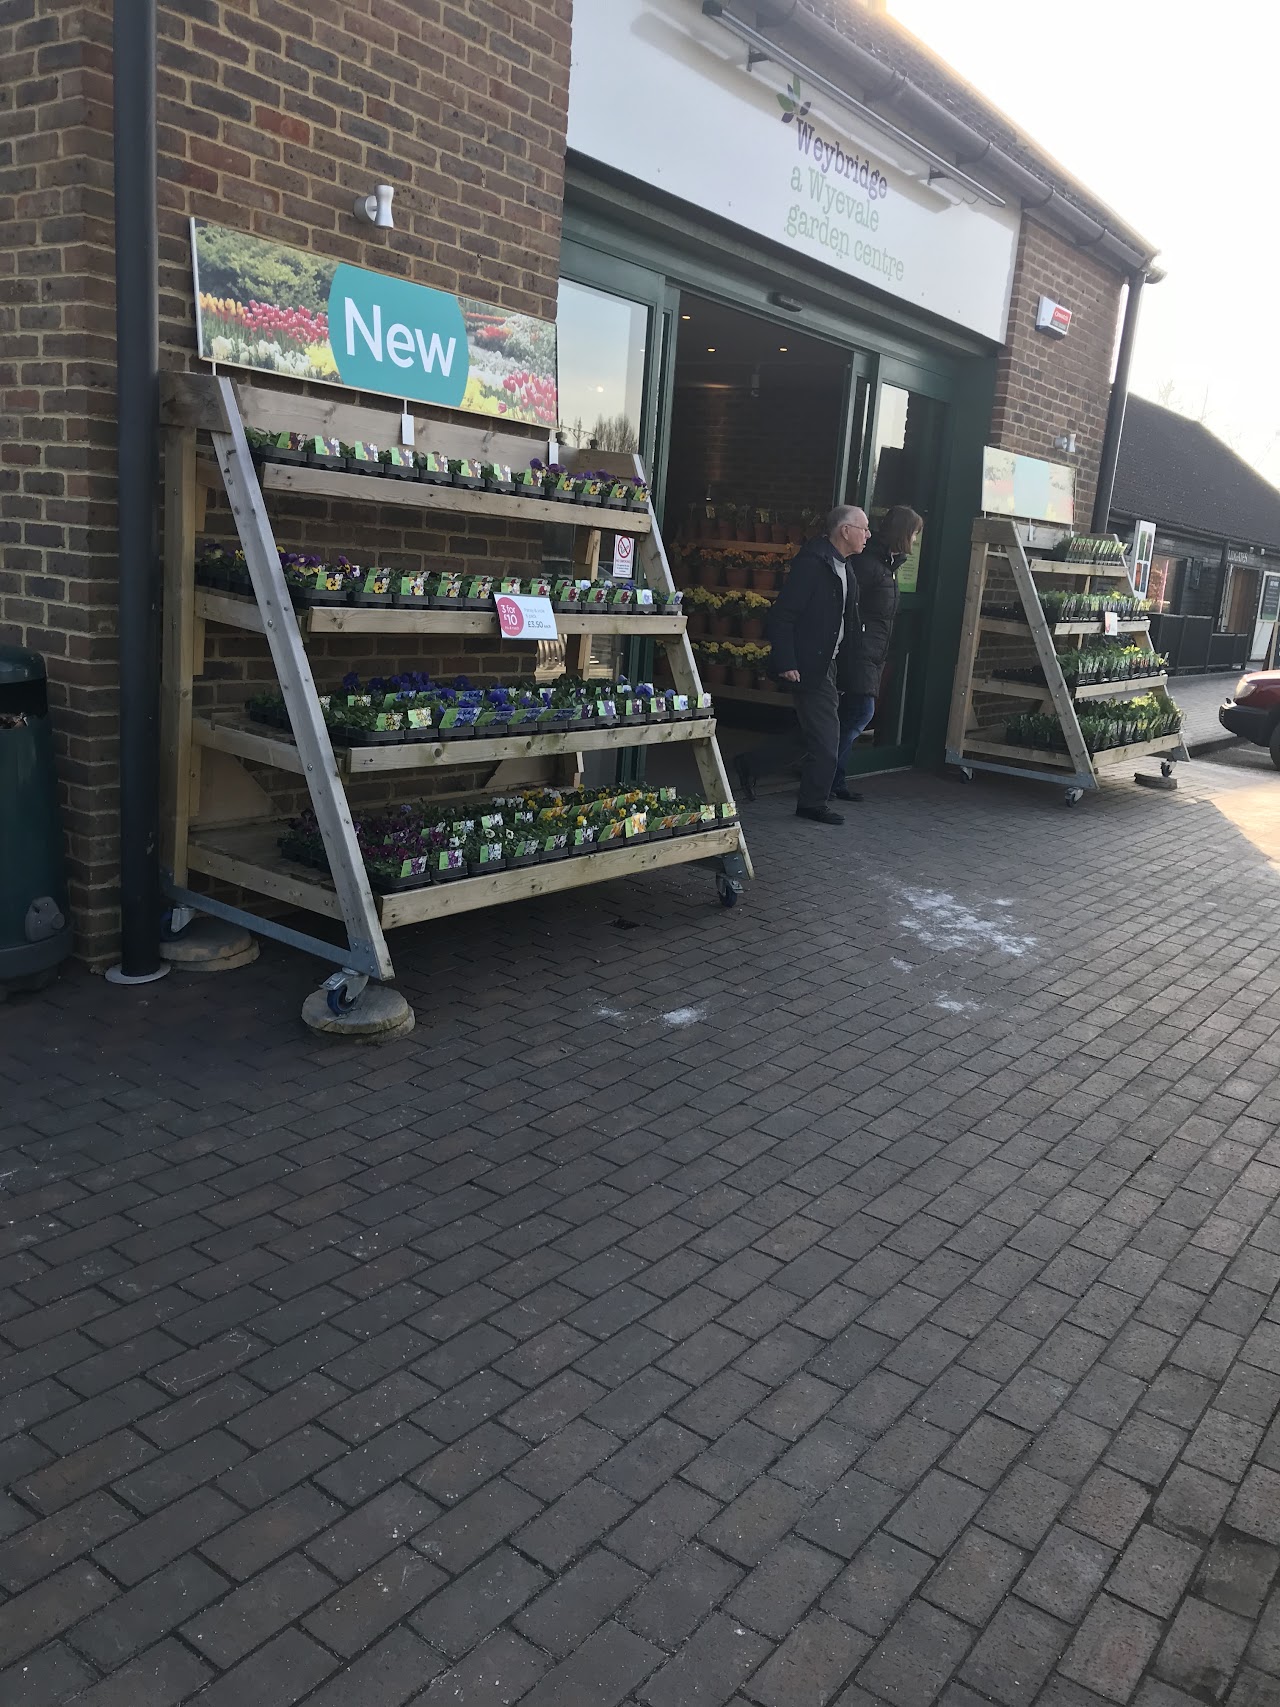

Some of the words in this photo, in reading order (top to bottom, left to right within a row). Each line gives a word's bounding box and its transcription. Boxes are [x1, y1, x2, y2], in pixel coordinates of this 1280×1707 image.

[796, 117, 888, 200] Weybridge
[790, 165, 803, 193] a
[808, 166, 879, 232] Wyevale
[786, 204, 850, 257] garden
[854, 239, 904, 281] centre
[344, 296, 457, 378] New
[501, 604, 506, 613] 3
[506, 605, 516, 614] for
[503, 614, 518, 626] £10
[528, 620, 544, 629] £3.50
